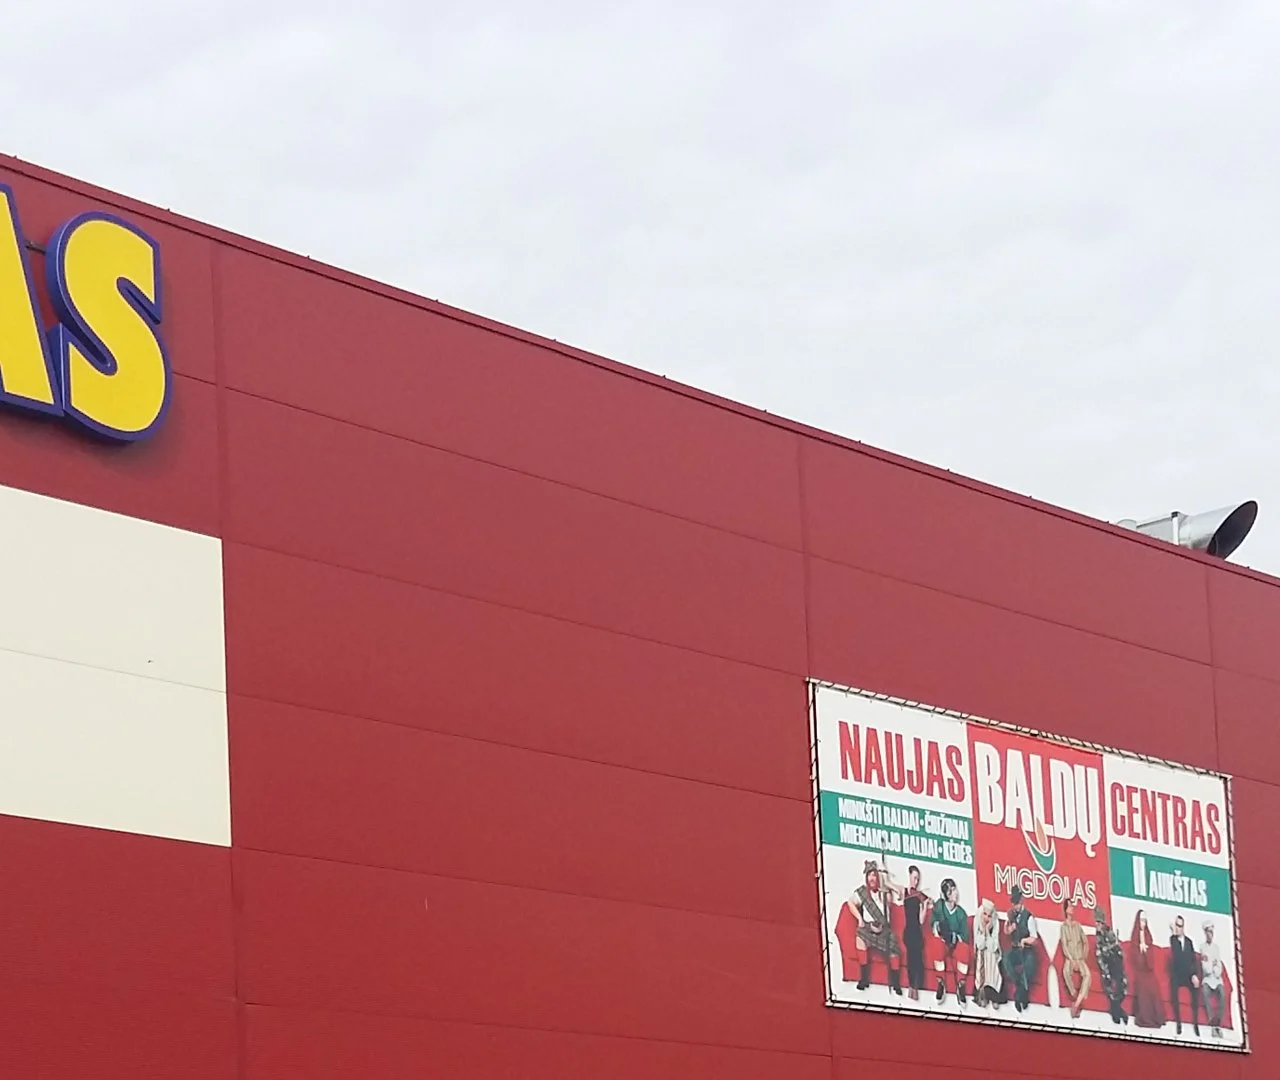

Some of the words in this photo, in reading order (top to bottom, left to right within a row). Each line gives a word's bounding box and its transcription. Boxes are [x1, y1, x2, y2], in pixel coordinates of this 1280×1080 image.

[838, 720, 966, 803] NAUJAS
[974, 741, 1103, 857] BALDŲ
[1111, 782, 1221, 855] CENTRAS
[1149, 869, 1208, 907] AUKŠTAS
